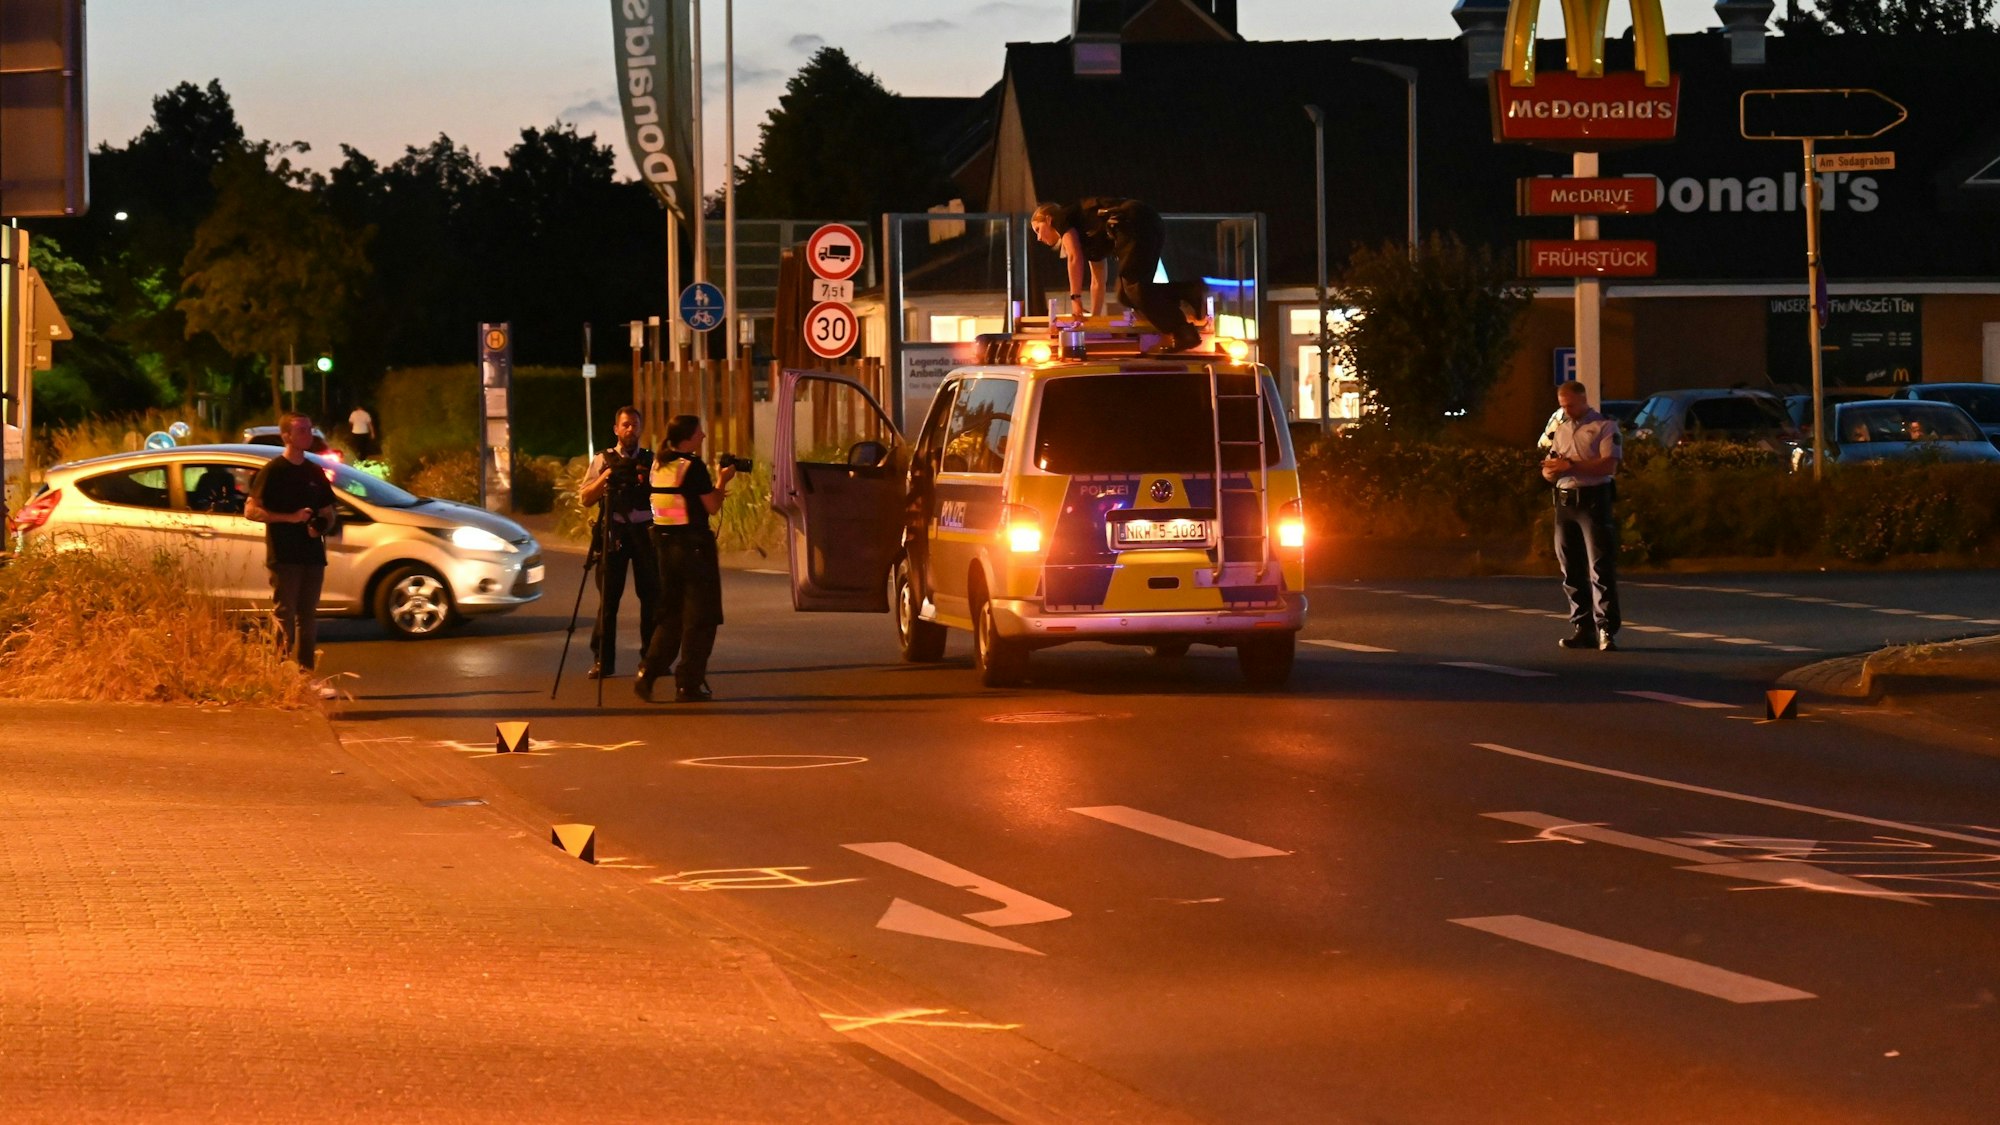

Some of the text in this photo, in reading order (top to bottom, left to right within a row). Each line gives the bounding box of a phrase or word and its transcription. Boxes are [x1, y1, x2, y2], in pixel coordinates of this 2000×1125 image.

[1509, 100, 1672, 119] McDonald's
[1820, 158, 1834, 167] Am
[1537, 172, 1879, 213] onald's
[1551, 189, 1634, 203] McDRIVE
[1537, 247, 1649, 267] FRÜHSTÜCK
[1771, 298, 1811, 313] UNSER
[817, 317, 846, 341] 30
[909, 357, 950, 368] Legende
[1080, 485, 1129, 496] POLIZEI
[941, 501, 968, 527] POLIZEI
[1159, 524, 1204, 538] 5-1081
